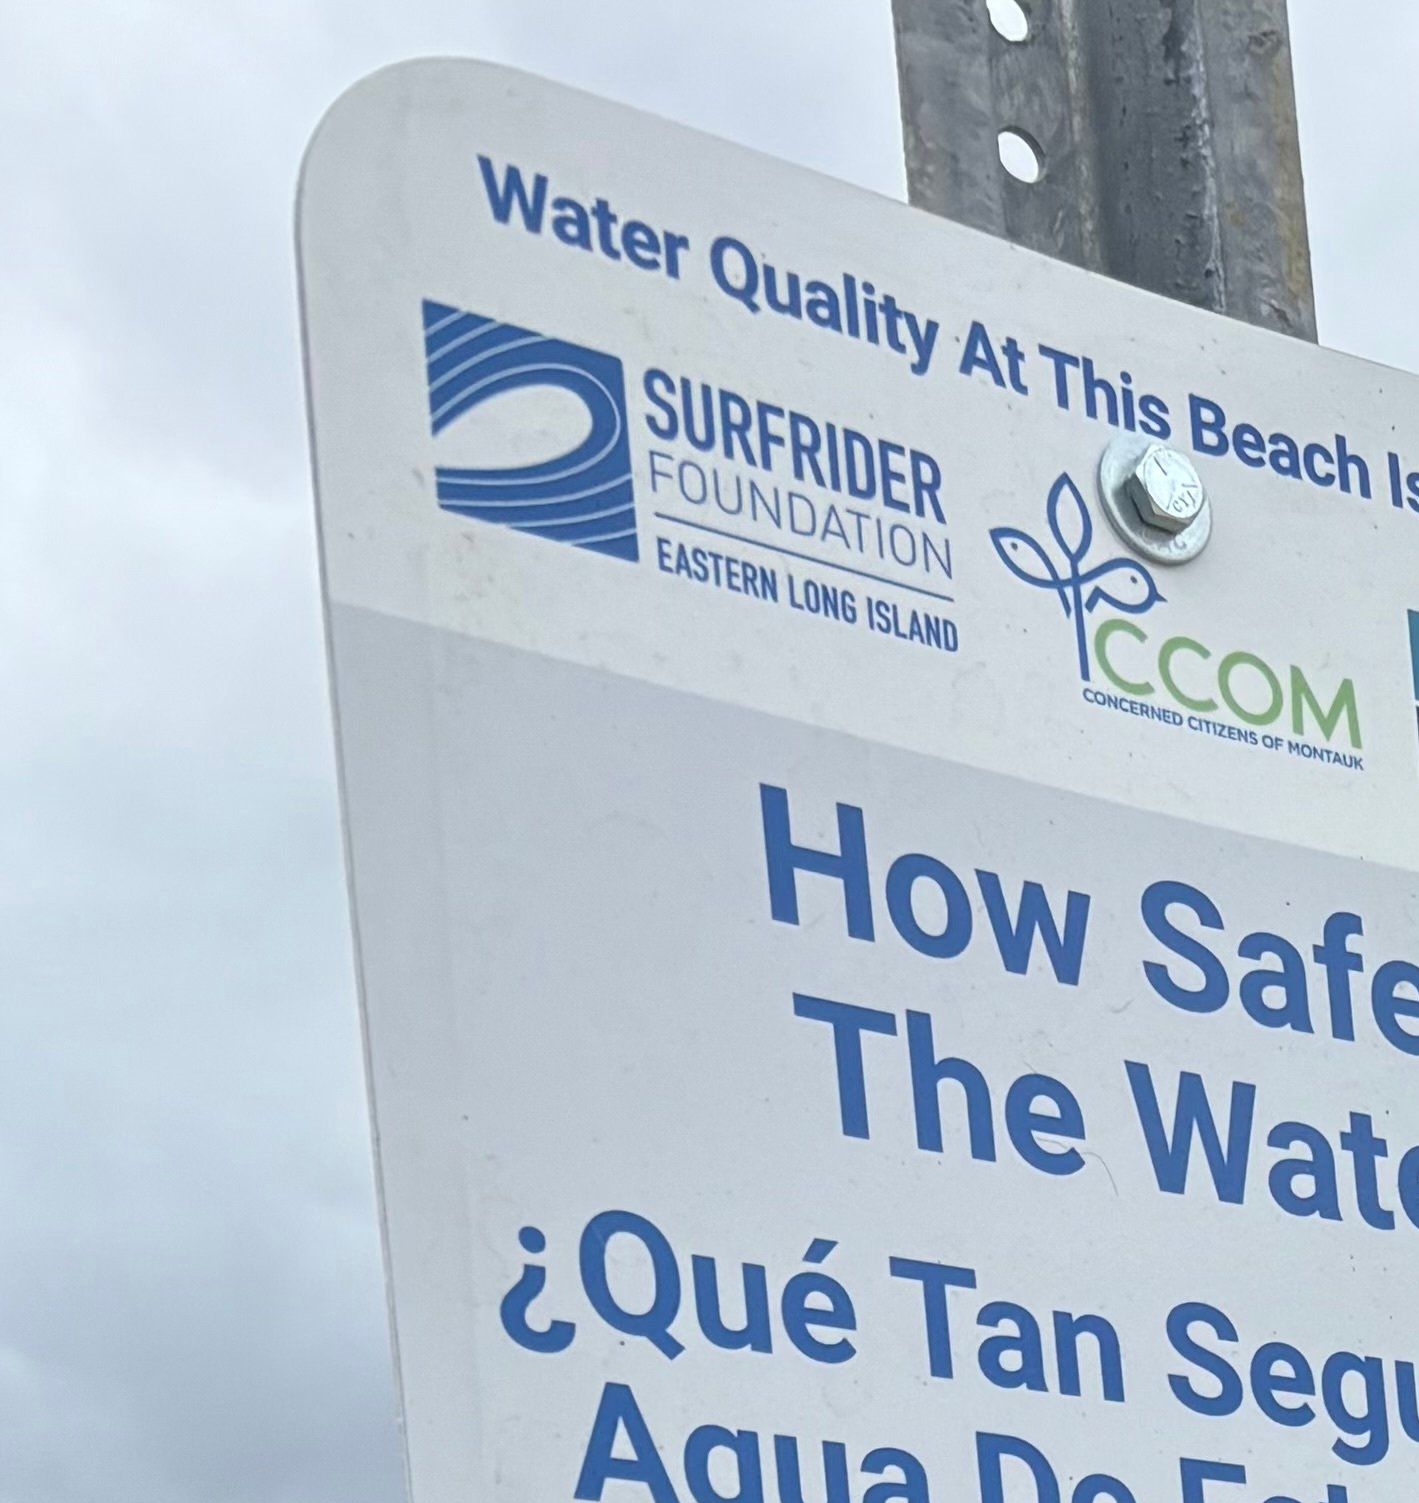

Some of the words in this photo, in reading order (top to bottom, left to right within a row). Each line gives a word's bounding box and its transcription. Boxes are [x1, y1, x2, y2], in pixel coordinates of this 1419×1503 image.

[479, 158, 688, 279] Water
[710, 238, 938, 375] Quality
[960, 323, 1028, 395] At
[1040, 347, 1171, 440] This
[1189, 395, 1370, 497] Beach
[643, 369, 944, 524] SURFRIDER
[648, 450, 953, 580] FOUNDATION
[657, 539, 777, 600] EASTERN
[789, 582, 856, 624] LONG
[868, 601, 957, 652] ISLAND
[1083, 687, 1183, 726] CONCERNED
[1188, 715, 1258, 745] CITIZENS
[1262, 734, 1283, 751] OF
[1289, 740, 1364, 771] MONTAUK
[1096, 620, 1360, 745] CCOM
[760, 784, 1090, 985] How
[793, 993, 1085, 1175] The
[500, 1210, 856, 1364] ¿Qué
[889, 1257, 1125, 1402] Tan
